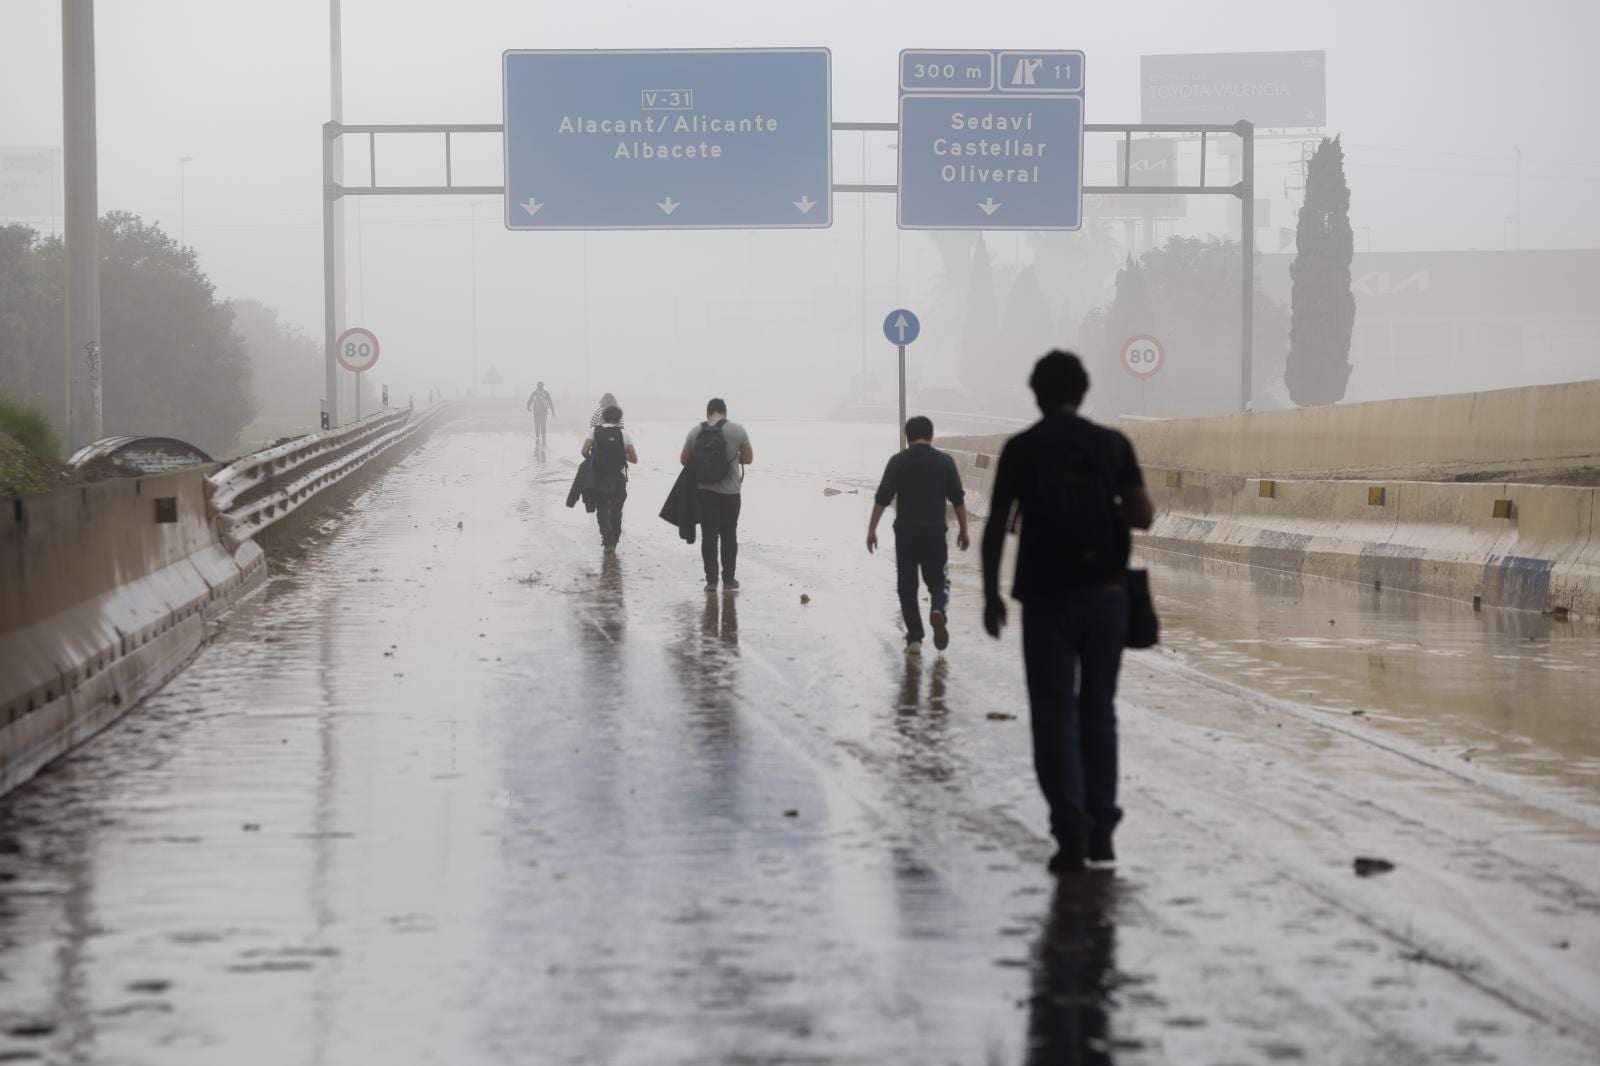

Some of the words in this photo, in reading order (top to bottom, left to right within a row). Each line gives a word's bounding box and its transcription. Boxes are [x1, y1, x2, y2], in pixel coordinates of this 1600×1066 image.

[914, 64, 955, 78] 300
[966, 67, 982, 79] m
[1054, 65, 1071, 79] 11
[1149, 84, 1210, 98] TOYOTA
[1213, 81, 1291, 97] VALENCIA
[645, 92, 691, 106] V-31
[558, 114, 779, 134] Alacant/Alicante
[951, 112, 1033, 130] Sedaví
[614, 142, 722, 160] Albacete
[933, 138, 1047, 157] Castellar
[941, 165, 1039, 183] Oliveral
[345, 342, 370, 357] 80
[1130, 349, 1155, 363] 80
